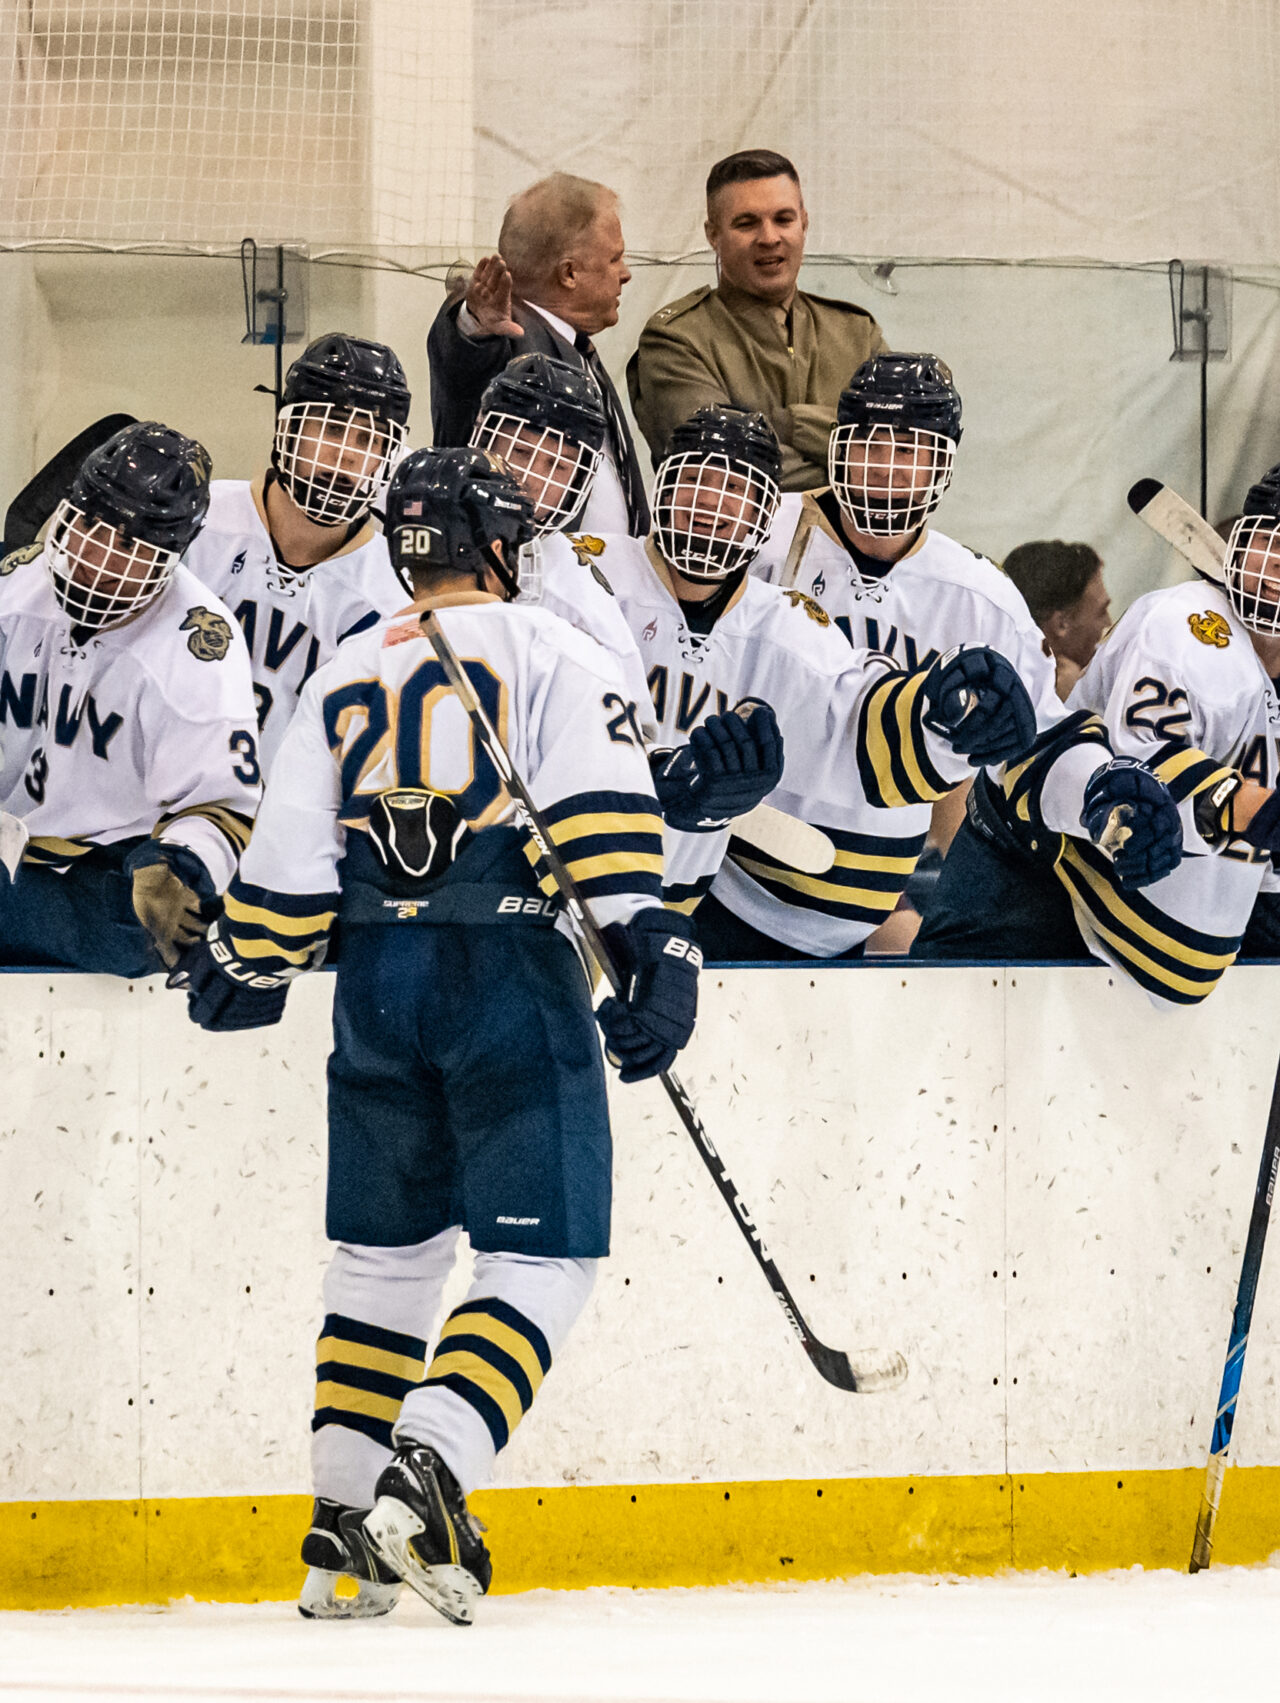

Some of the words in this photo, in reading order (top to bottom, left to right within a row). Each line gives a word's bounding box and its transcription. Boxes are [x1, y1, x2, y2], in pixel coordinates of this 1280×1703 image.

[400, 529, 431, 555] 20
[0, 669, 125, 763] NVY
[1125, 675, 1193, 743] 22
[228, 729, 262, 788] 3
[321, 656, 510, 833] 20
[496, 1215, 541, 1226] BAUER
